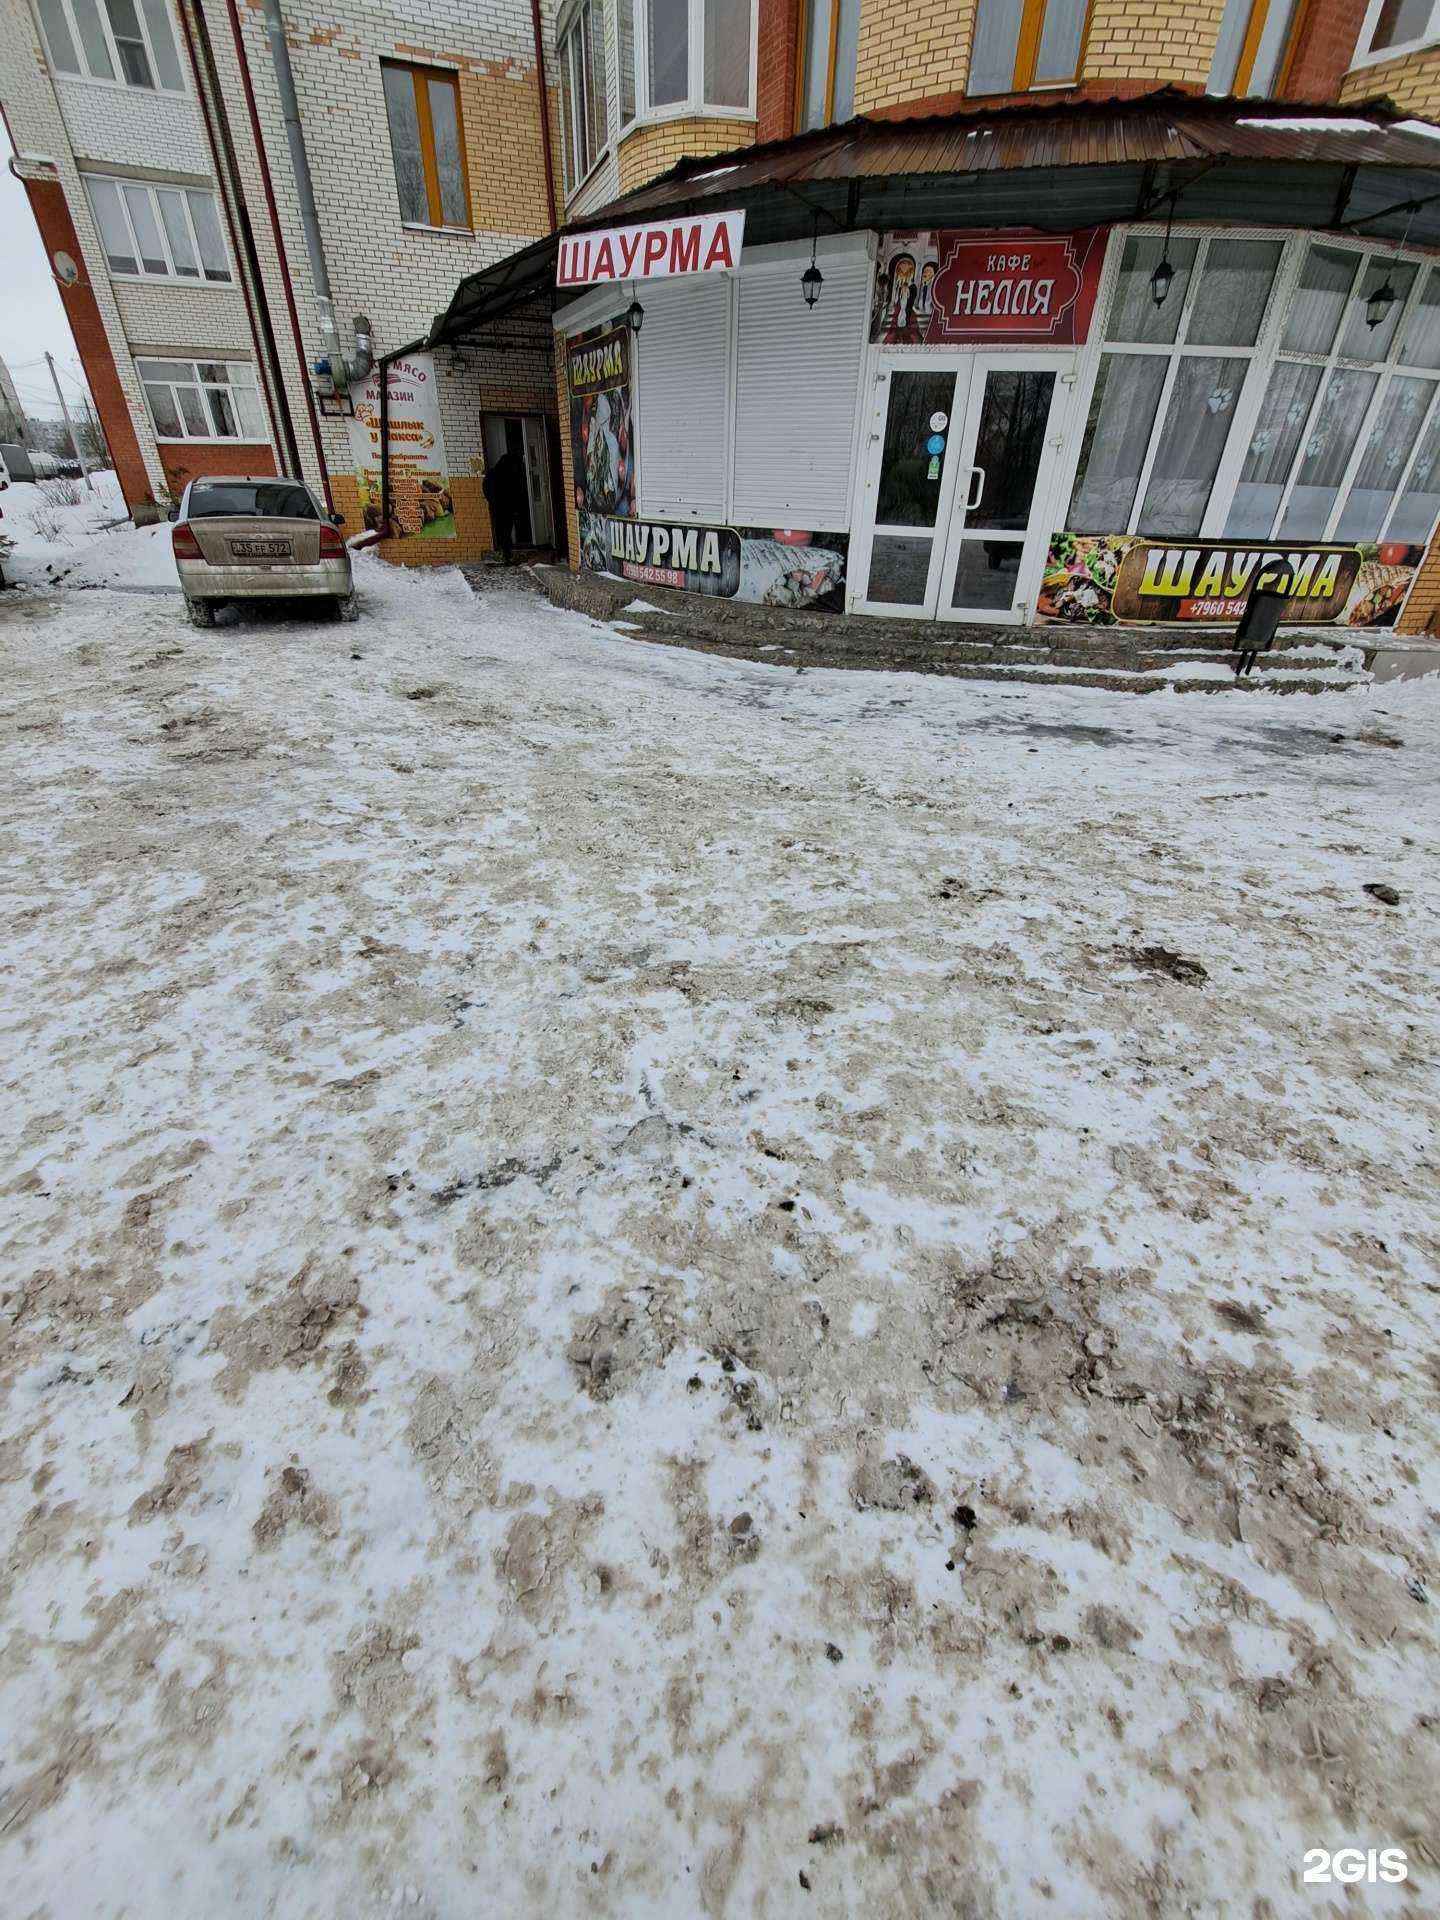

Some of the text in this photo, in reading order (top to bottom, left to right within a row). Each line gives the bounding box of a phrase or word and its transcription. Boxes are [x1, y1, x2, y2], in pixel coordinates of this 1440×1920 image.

[559, 221, 733, 284] ШАУРМА
[987, 254, 1031, 272] КАФЕ
[953, 279, 1056, 315] НЕЛЛЯ
[572, 340, 623, 386] ШАУРМА
[366, 390, 414, 402] МААЗИН
[268, 543, 286, 553] 572
[610, 521, 721, 574] ШАУРМА
[639, 567, 654, 580] 542
[667, 570, 678, 584] 98
[1190, 601, 1225, 616] +7960
